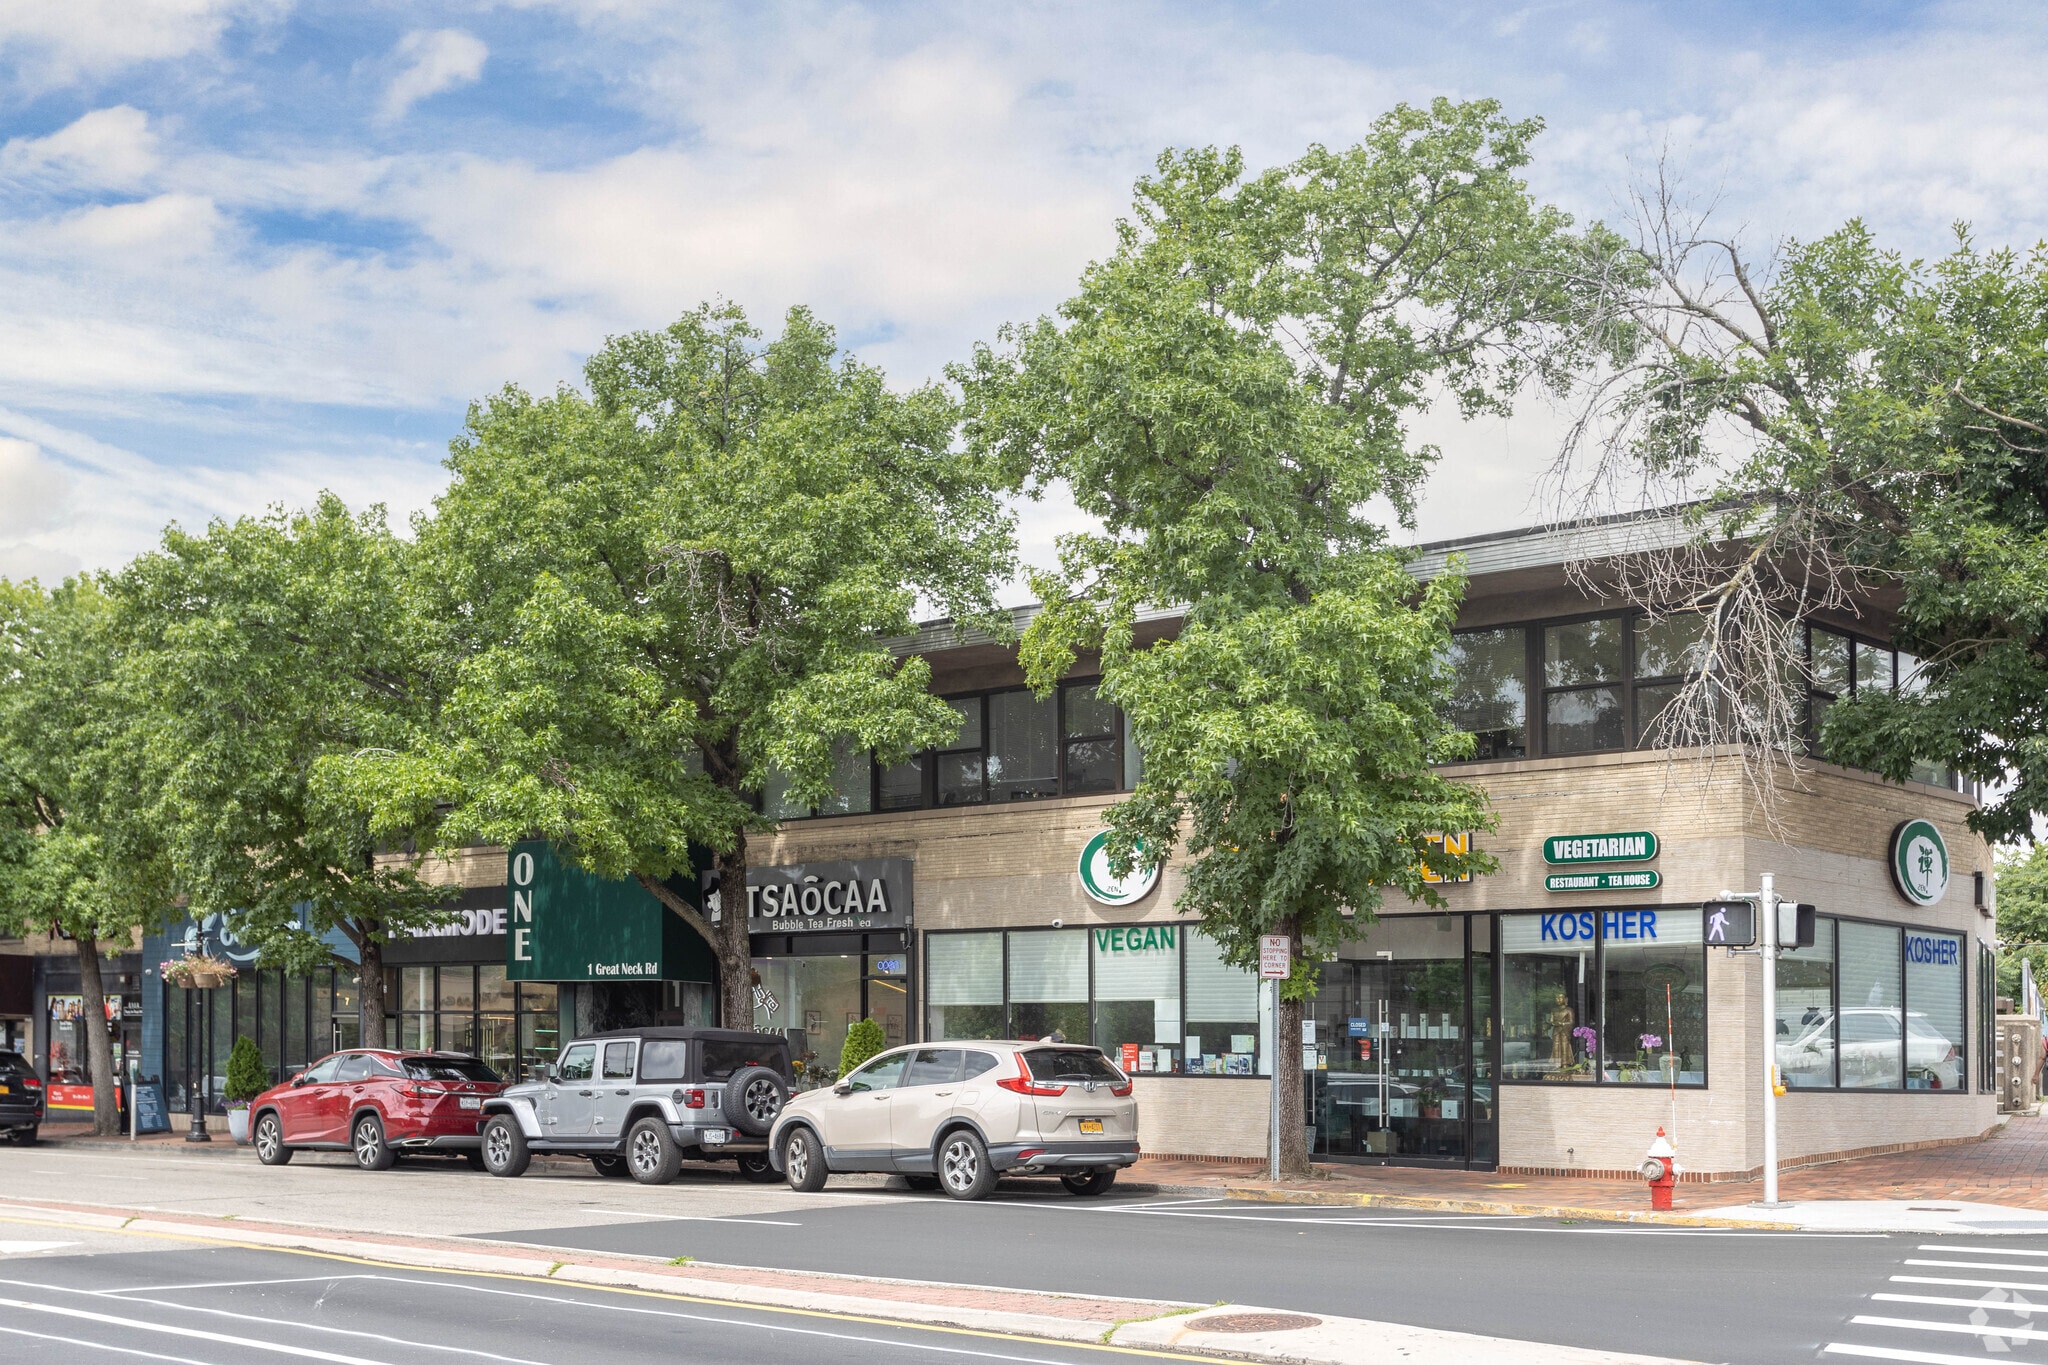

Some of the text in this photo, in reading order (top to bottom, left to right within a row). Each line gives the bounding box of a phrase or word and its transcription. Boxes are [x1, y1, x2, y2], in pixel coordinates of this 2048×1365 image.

[1553, 836, 1646, 859] VEGETARIAN
[1549, 874, 1651, 889] RESTAURANT TEA HOUSE
[513, 852, 534, 961] ONE
[772, 919, 804, 930] Bubble
[808, 918, 823, 929] Tea
[827, 917, 853, 928] Fresh
[1095, 926, 1175, 952] VEGAN
[1269, 938, 1281, 947] NO
[1905, 936, 1958, 965] KOSHER
[587, 962, 658, 975] 1 Great Neck Rd
